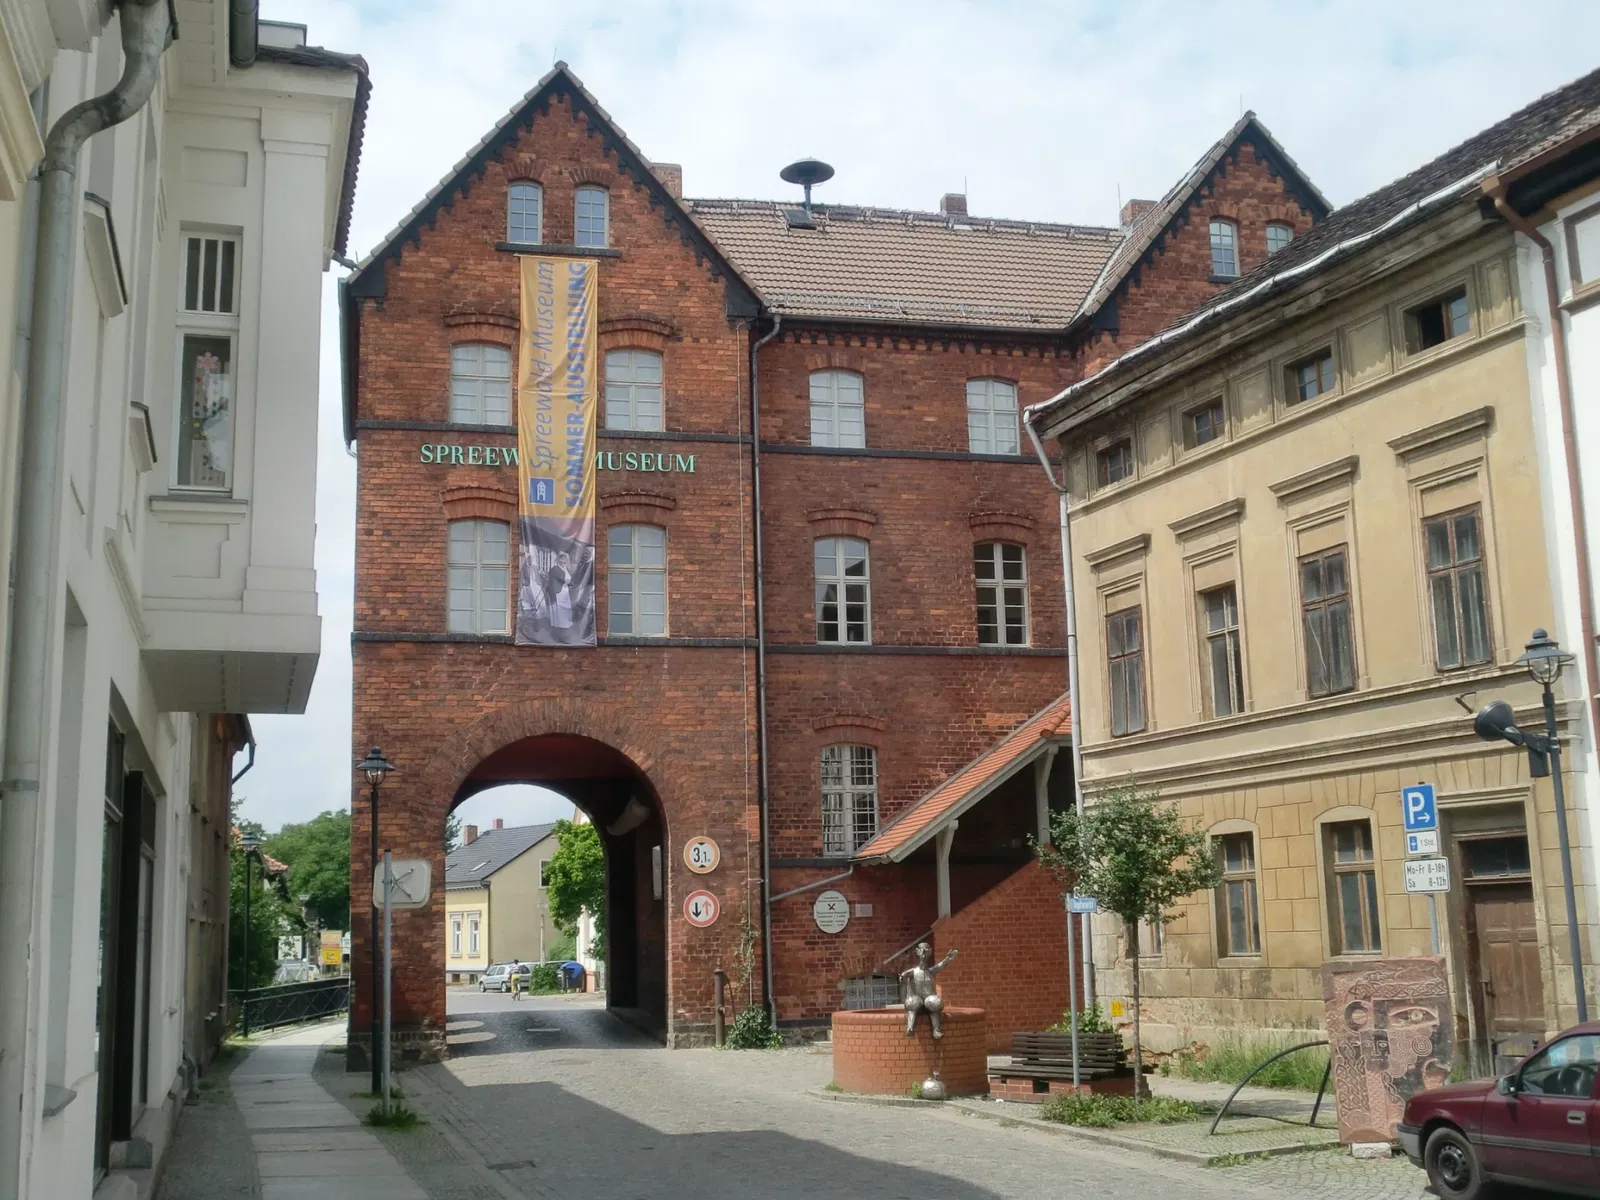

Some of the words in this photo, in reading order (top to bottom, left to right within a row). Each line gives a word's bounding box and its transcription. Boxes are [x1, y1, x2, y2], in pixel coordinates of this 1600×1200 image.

[530, 260, 558, 472] Spreewald-Museum
[565, 261, 588, 507] SOMMER-AUSSTELLUNG
[1407, 791, 1425, 825] P
[1407, 864, 1425, 875] Mo-Fr
[1408, 878, 1416, 888] Sa
[1428, 876, 1447, 887] 8-12h
